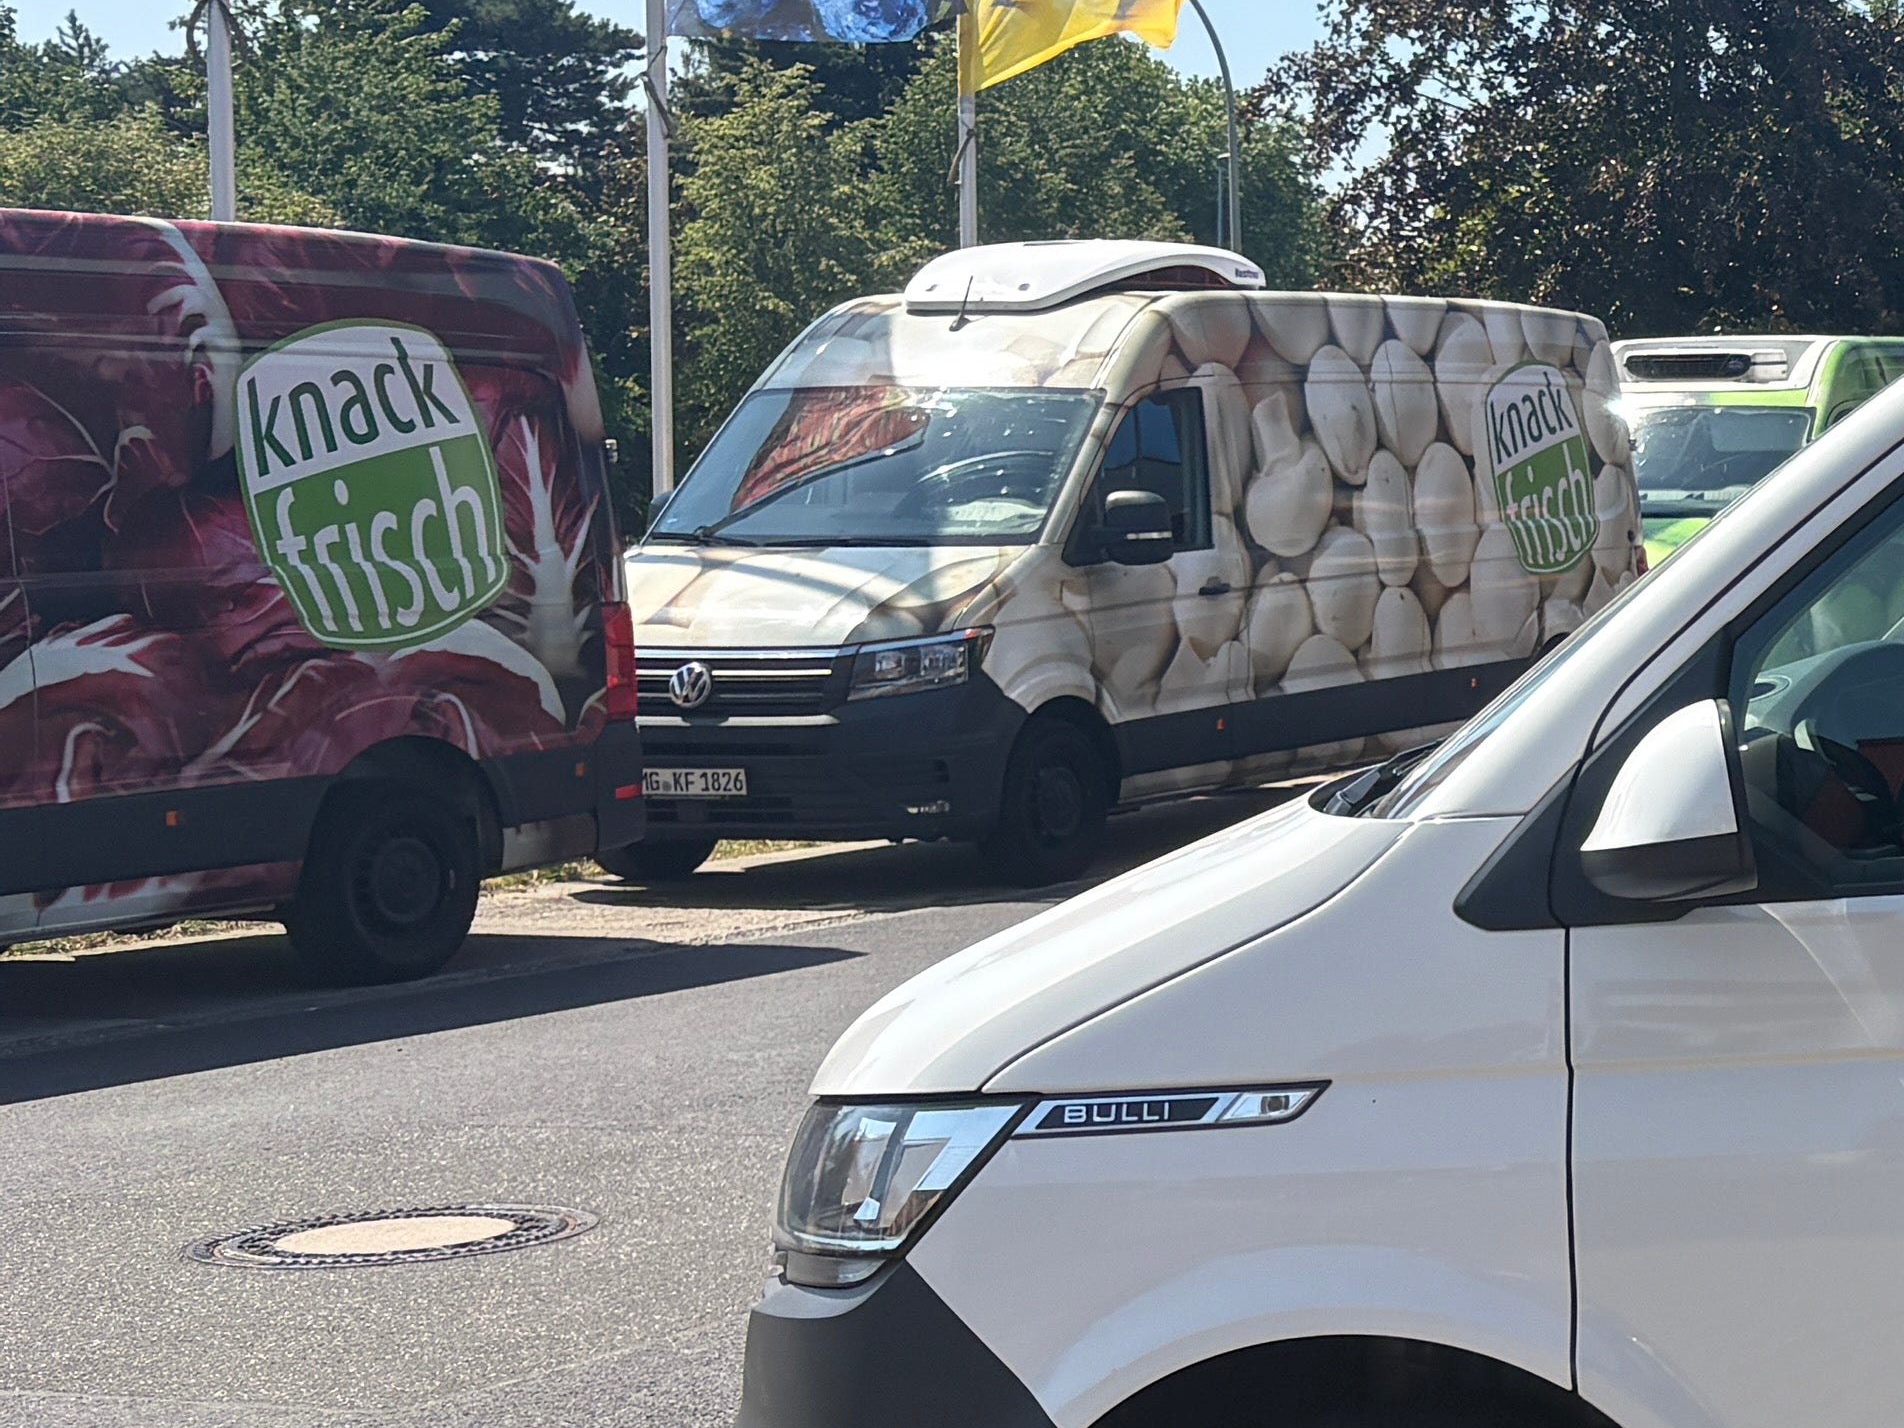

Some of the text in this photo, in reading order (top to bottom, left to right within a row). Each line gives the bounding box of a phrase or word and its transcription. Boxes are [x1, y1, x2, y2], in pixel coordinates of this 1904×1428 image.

[247, 337, 460, 477] knack
[1490, 371, 1573, 464] knack
[276, 446, 496, 632] frisch
[1506, 442, 1595, 565] frisch
[673, 772, 695, 792] KF
[699, 772, 743, 792] 1826
[1064, 1102, 1169, 1123] BULLI
